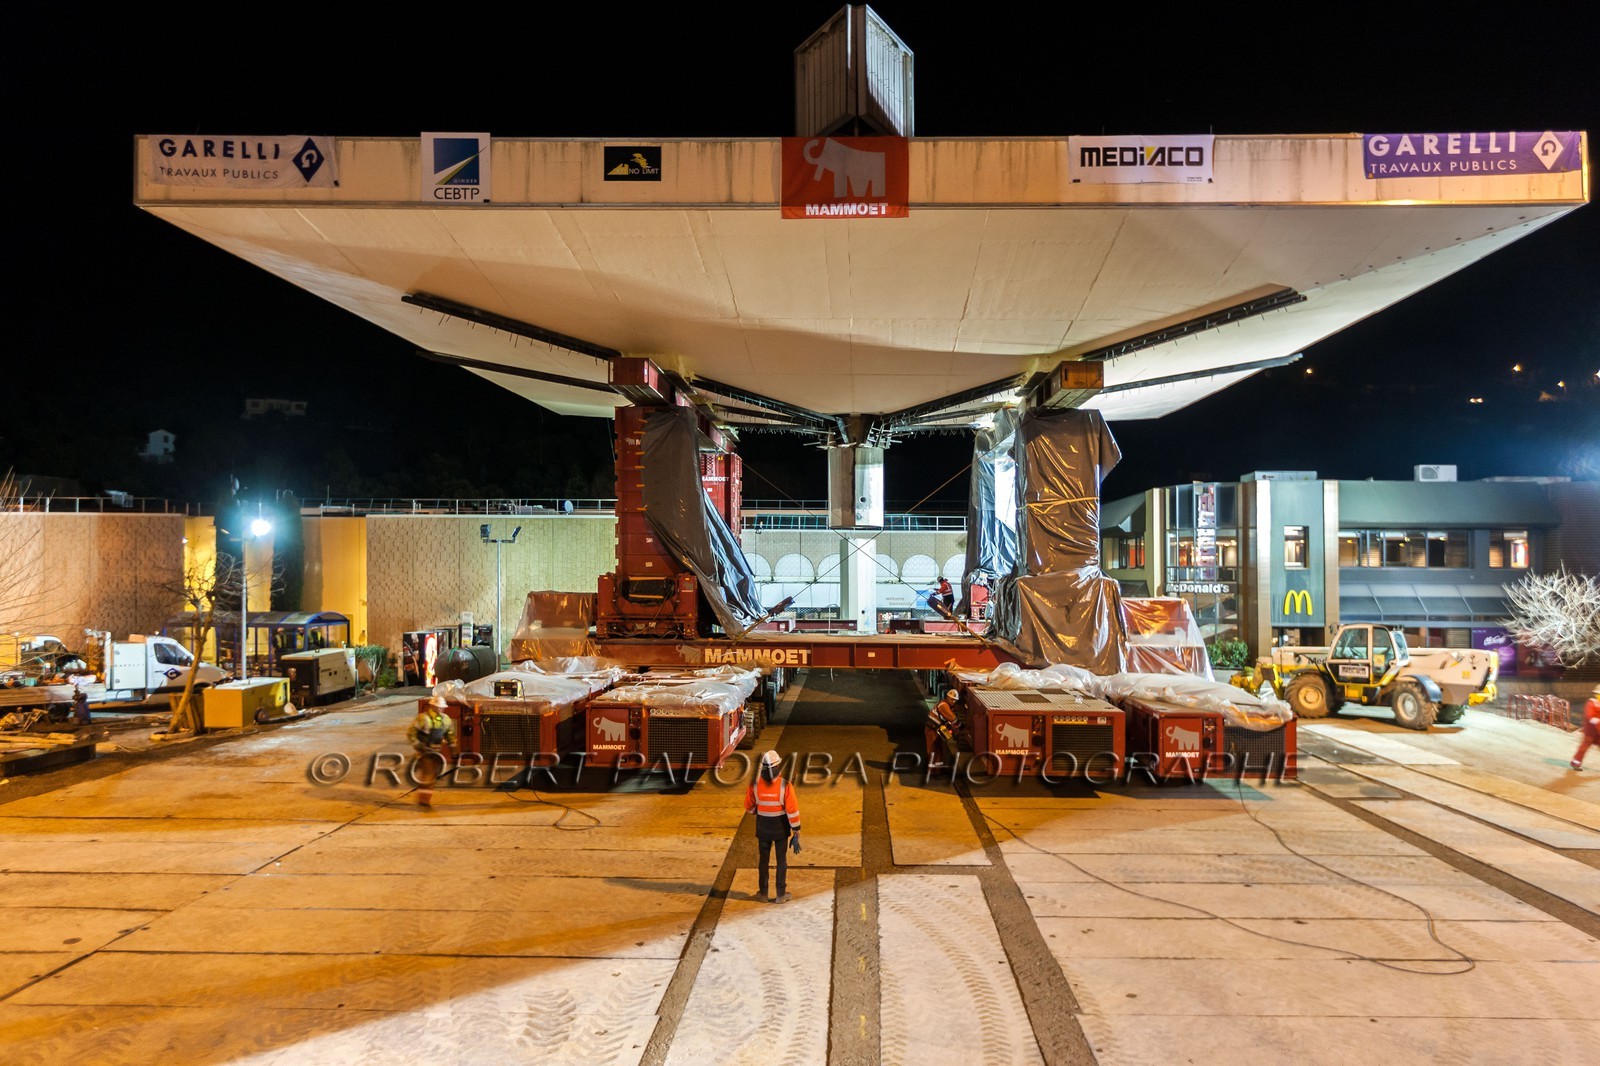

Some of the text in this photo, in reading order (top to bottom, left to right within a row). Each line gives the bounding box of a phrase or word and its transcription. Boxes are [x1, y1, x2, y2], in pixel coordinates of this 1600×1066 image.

[159, 138, 280, 160] GARELLI
[1368, 131, 1516, 157] GARELLI
[1080, 147, 1204, 167] MEDIACO
[159, 166, 279, 180] TRAVAUX PUBLICS
[642, 167, 659, 175] LIMIT
[1370, 159, 1517, 174] TRAVAUX PUBLICS
[433, 187, 480, 200] CEBTP
[805, 202, 889, 216] MAMMOET
[1165, 583, 1230, 594] McDonald's
[704, 648, 809, 665] MAMMOET
